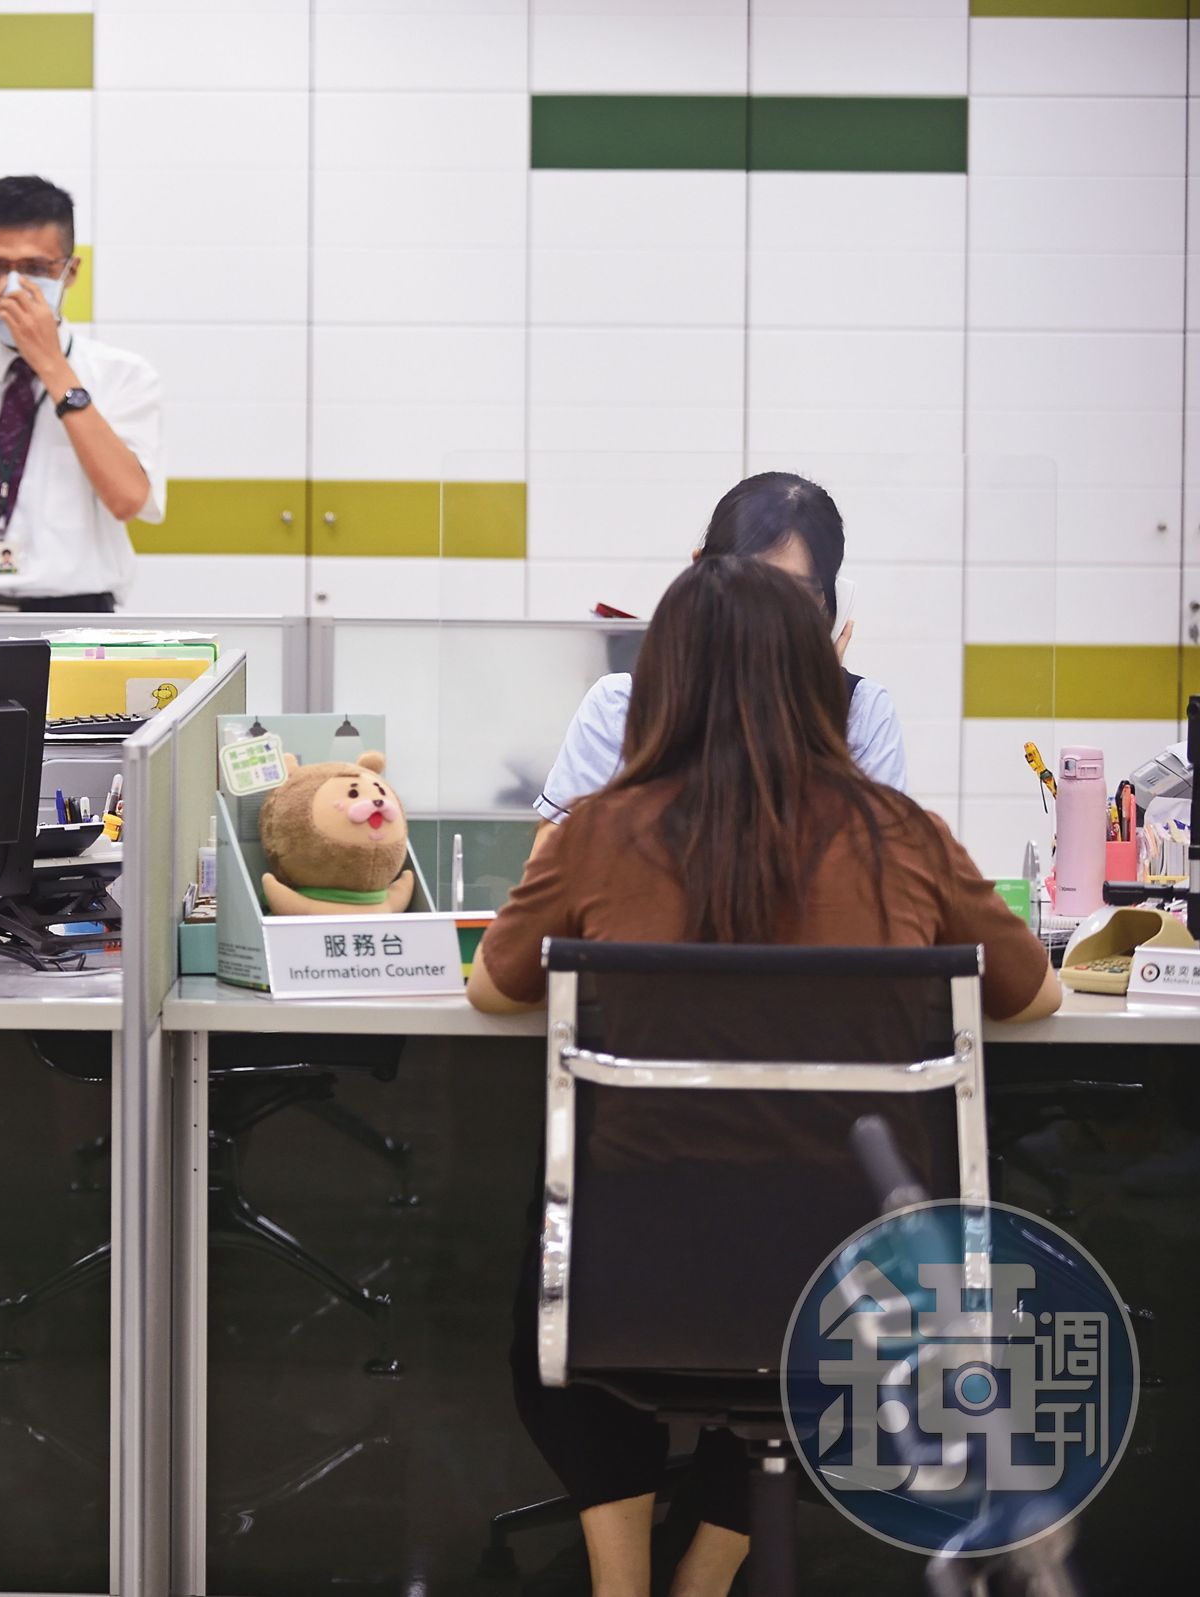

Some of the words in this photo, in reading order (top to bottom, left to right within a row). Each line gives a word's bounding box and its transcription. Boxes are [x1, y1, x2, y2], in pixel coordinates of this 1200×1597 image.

[324, 933, 403, 958] 服務台
[289, 964, 381, 980] Information
[385, 963, 446, 978] Counter
